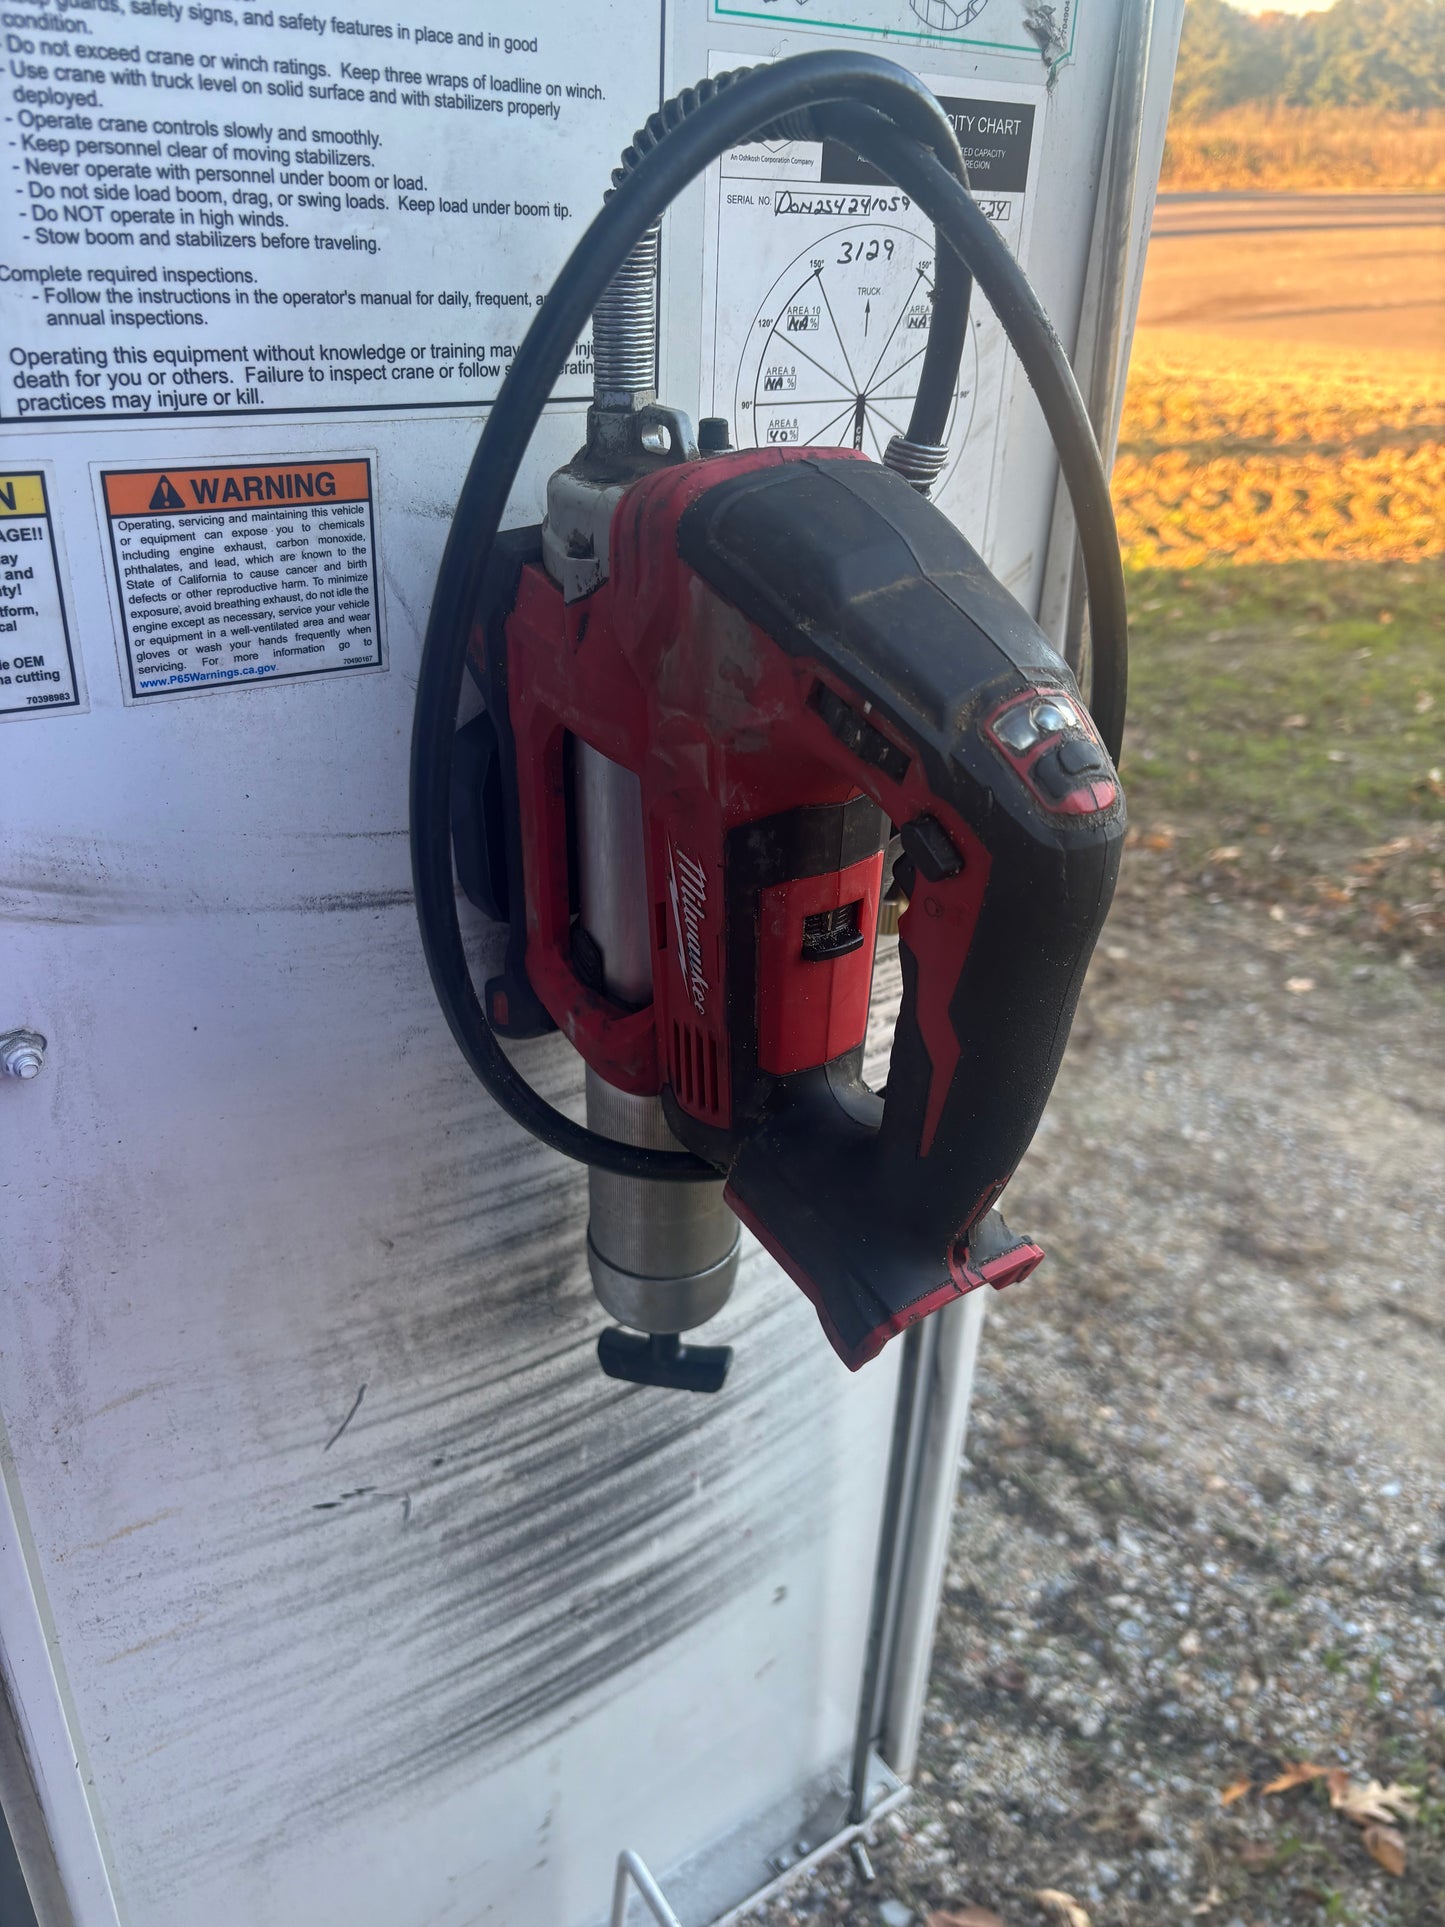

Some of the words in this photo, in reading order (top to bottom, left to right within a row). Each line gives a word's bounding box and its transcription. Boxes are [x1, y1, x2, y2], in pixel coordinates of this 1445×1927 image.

[1, 12, 92, 34] condition.
[5, 33, 35, 54] Do
[39, 39, 70, 57] not
[74, 44, 140, 63] exceed
[145, 49, 194, 66] crane
[199, 54, 216, 68] or
[220, 53, 268, 72] winch
[273, 58, 330, 80] ratings.
[340, 61, 380, 84] Keep
[384, 66, 421, 84] three
[425, 73, 468, 91] wraps
[472, 74, 486, 89] of
[490, 74, 541, 94] loadline
[545, 83, 561, 96] on
[565, 82, 605, 100] winch.
[12, 85, 103, 110] deployed.
[17, 108, 92, 131] Operate
[97, 117, 147, 133] crane
[152, 119, 218, 136] controls
[223, 121, 272, 143] slowly
[277, 125, 306, 141] and
[311, 129, 382, 150] smoothly.
[946, 114, 975, 132] CITY
[977, 117, 1022, 135] CHART
[20, 133, 70, 156] Keep
[75, 139, 161, 157] personnel
[166, 141, 207, 158] clear
[212, 142, 228, 159] of
[232, 145, 290, 167] moving
[295, 148, 374, 167] stabilizers.
[730, 153, 738, 161] An
[739, 153, 761, 162] Oshkosh
[761, 156, 790, 165] Corporation
[791, 157, 814, 167] Company
[974, 148, 1006, 158] CAPACITY
[24, 157, 79, 176] Never
[84, 162, 151, 181] operate
[155, 163, 190, 180] with
[195, 167, 274, 184] personnel
[279, 169, 324, 185] under
[328, 170, 369, 187] boom
[374, 176, 389, 189] or
[393, 174, 427, 191] load.
[727, 194, 754, 205] SERIAL
[31, 203, 58, 221] Do
[63, 204, 104, 222] NOT
[110, 208, 174, 226] operate
[179, 207, 194, 224] in
[199, 208, 233, 229] high
[238, 210, 288, 227] winds.
[35, 226, 79, 244] Stow
[84, 227, 134, 245] boom
[139, 229, 170, 246] and
[175, 230, 256, 247] stabilizers
[260, 232, 309, 249] before
[313, 234, 380, 254] traveling.
[837, 239, 894, 264] 3129
[0, 264, 81, 285] Complete
[87, 265, 157, 285] required
[162, 266, 257, 286] inspections.
[858, 287, 881, 296] TRUCK
[46, 309, 105, 326] annual
[110, 308, 207, 328] inspections.
[787, 306, 809, 314] AREA
[812, 306, 821, 314] 10
[910, 305, 930, 314] AREA
[766, 367, 788, 375] AREA
[791, 367, 796, 375] 9
[16, 392, 105, 413] practices
[111, 394, 151, 411] may
[157, 389, 207, 410] injure
[213, 392, 231, 405] or
[236, 387, 263, 404] kill.
[769, 419, 791, 428] AREA
[189, 471, 336, 504] WARNING
[117, 518, 174, 532] Operating,
[178, 514, 224, 527] servicing
[228, 512, 247, 523] and
[251, 509, 307, 521] maintaining
[310, 507, 328, 517] this
[331, 504, 364, 515] vehicle
[0, 527, 43, 542] AGE!!
[119, 537, 131, 546] or
[140, 531, 196, 545] equipment
[204, 531, 223, 539] can
[231, 527, 267, 538] expose
[276, 526, 293, 536] you
[301, 523, 311, 532] to
[318, 518, 365, 530] chemicals
[121, 548, 169, 560] including
[179, 544, 214, 557] engine
[223, 540, 266, 552] exhaust,
[275, 537, 309, 548] carbon
[317, 532, 365, 544] monoxide,
[0, 554, 18, 567] ay
[124, 563, 182, 577] phthalates,
[188, 558, 208, 569] and
[214, 556, 239, 567] lead,
[244, 553, 273, 564] which
[279, 553, 295, 561] are
[301, 550, 332, 559] known
[337, 547, 346, 556] to
[351, 545, 366, 555] the
[5, 567, 34, 580] and
[126, 579, 154, 589] State
[161, 576, 171, 586] of
[178, 572, 226, 585] California
[232, 571, 243, 580] to
[249, 568, 279, 578] cause
[285, 564, 317, 575] cancer
[323, 560, 341, 571] and
[346, 558, 367, 569] birth
[128, 592, 167, 604] defects
[170, 592, 181, 600] or
[185, 588, 212, 598] other
[216, 581, 277, 596] reproductive
[281, 579, 308, 589] harm.
[312, 576, 324, 585] To
[327, 572, 368, 584] minimize
[0, 606, 39, 617] tform,
[13, 655, 45, 669] OEM
[15, 670, 61, 683] cutting
[26, 692, 71, 704] 70398983
[676, 849, 709, 1015] Milwaukee
